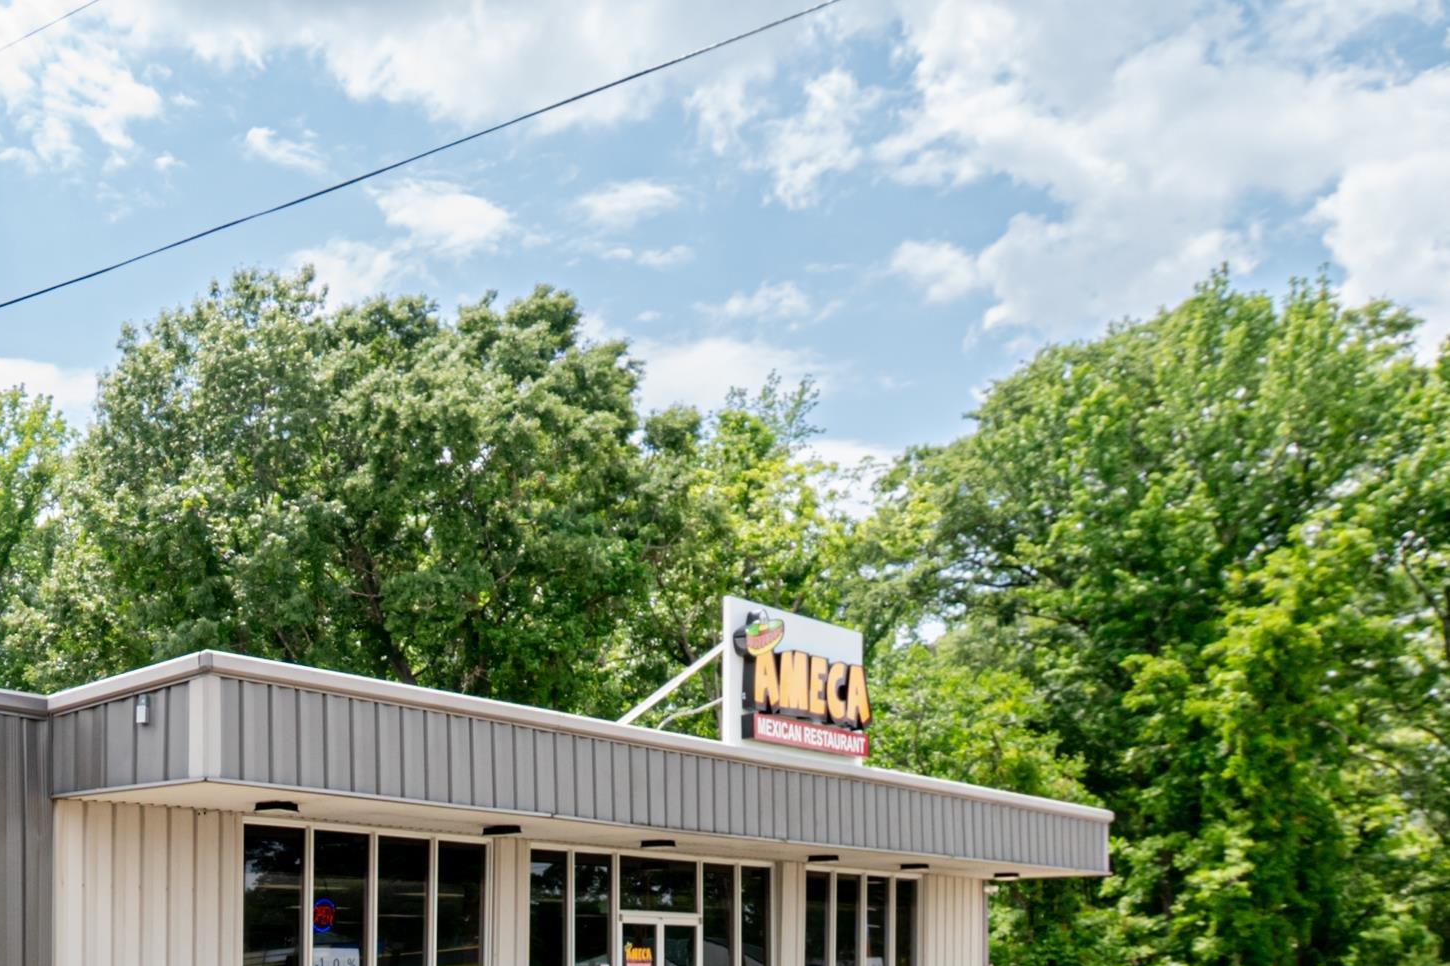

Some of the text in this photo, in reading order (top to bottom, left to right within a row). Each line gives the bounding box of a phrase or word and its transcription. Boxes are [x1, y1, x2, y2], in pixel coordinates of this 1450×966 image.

[754, 650, 871, 726] AMECA
[757, 717, 866, 754] MEXICAN RESTAURANT
